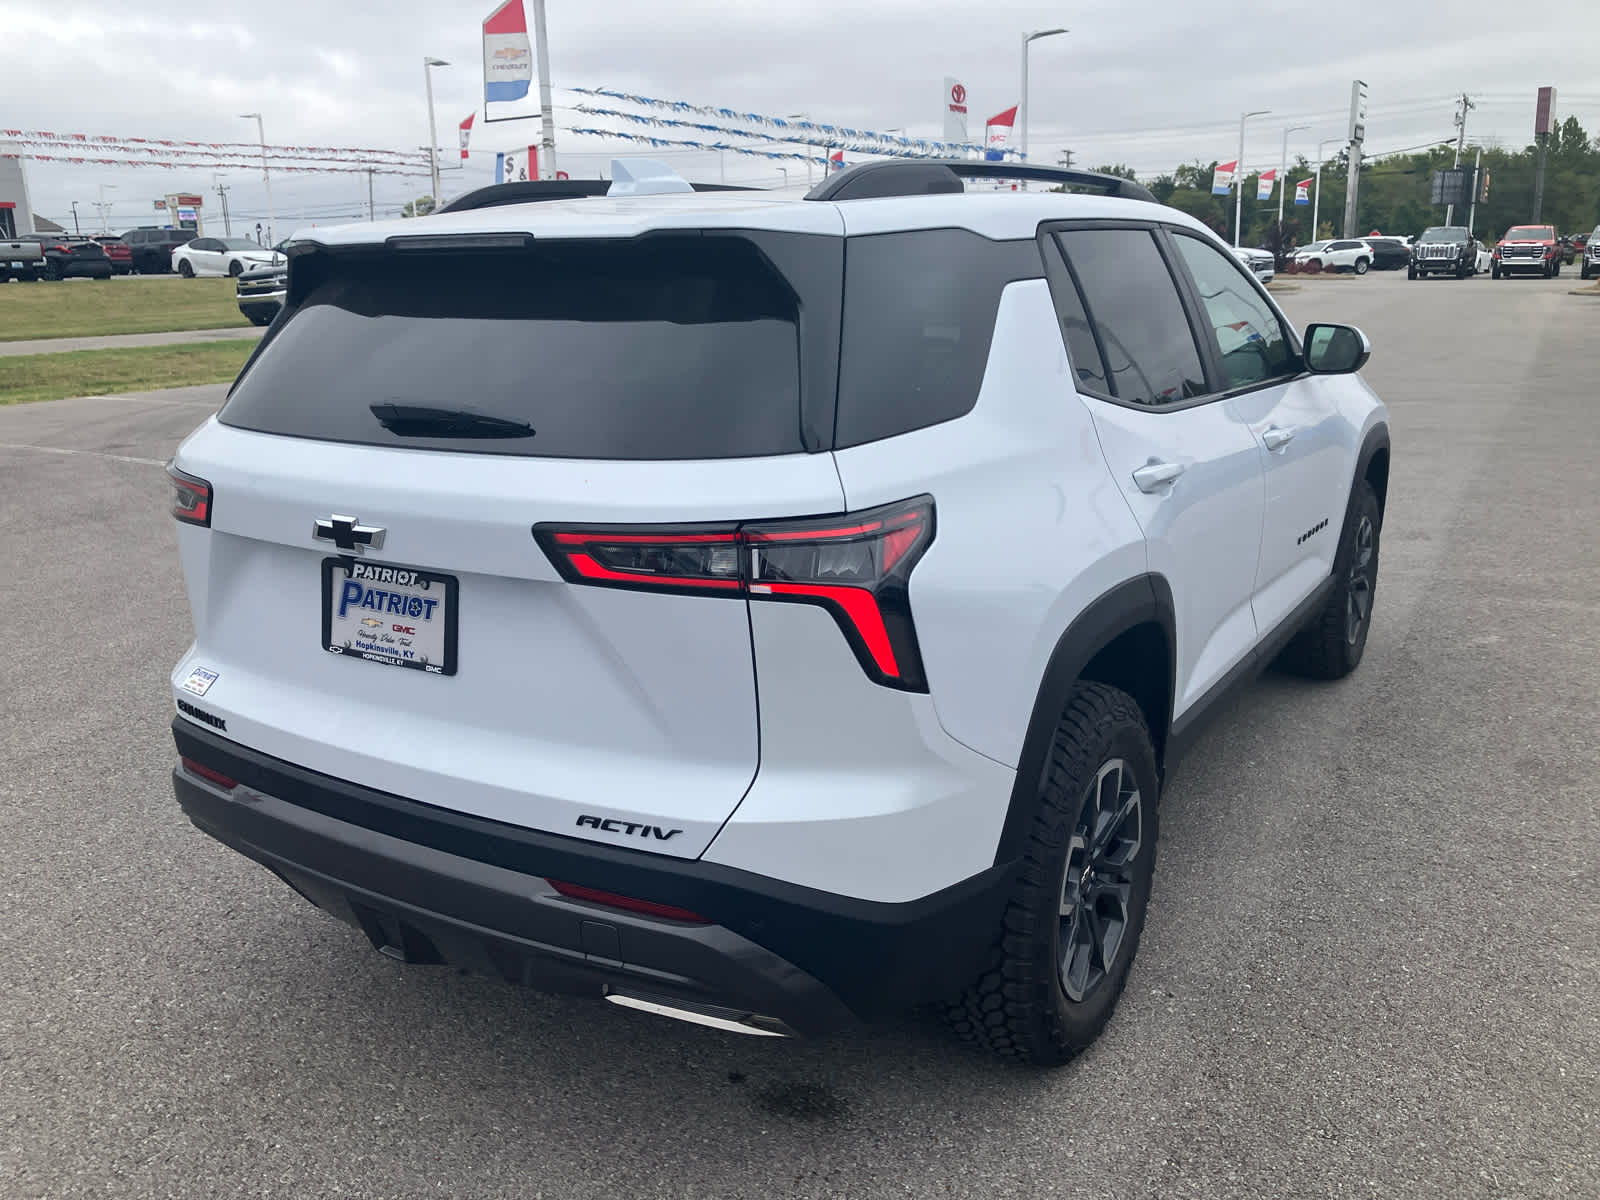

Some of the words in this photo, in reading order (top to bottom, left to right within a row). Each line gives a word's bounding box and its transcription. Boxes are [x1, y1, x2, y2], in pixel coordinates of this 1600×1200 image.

[352, 563, 418, 586] PATRIOT
[338, 580, 438, 620] PATRIOT
[392, 624, 416, 636] GMC
[355, 639, 401, 657] Hopkinsville,
[403, 649, 415, 660] KY
[425, 664, 443, 674] GMC
[576, 814, 684, 840] ACTIV
